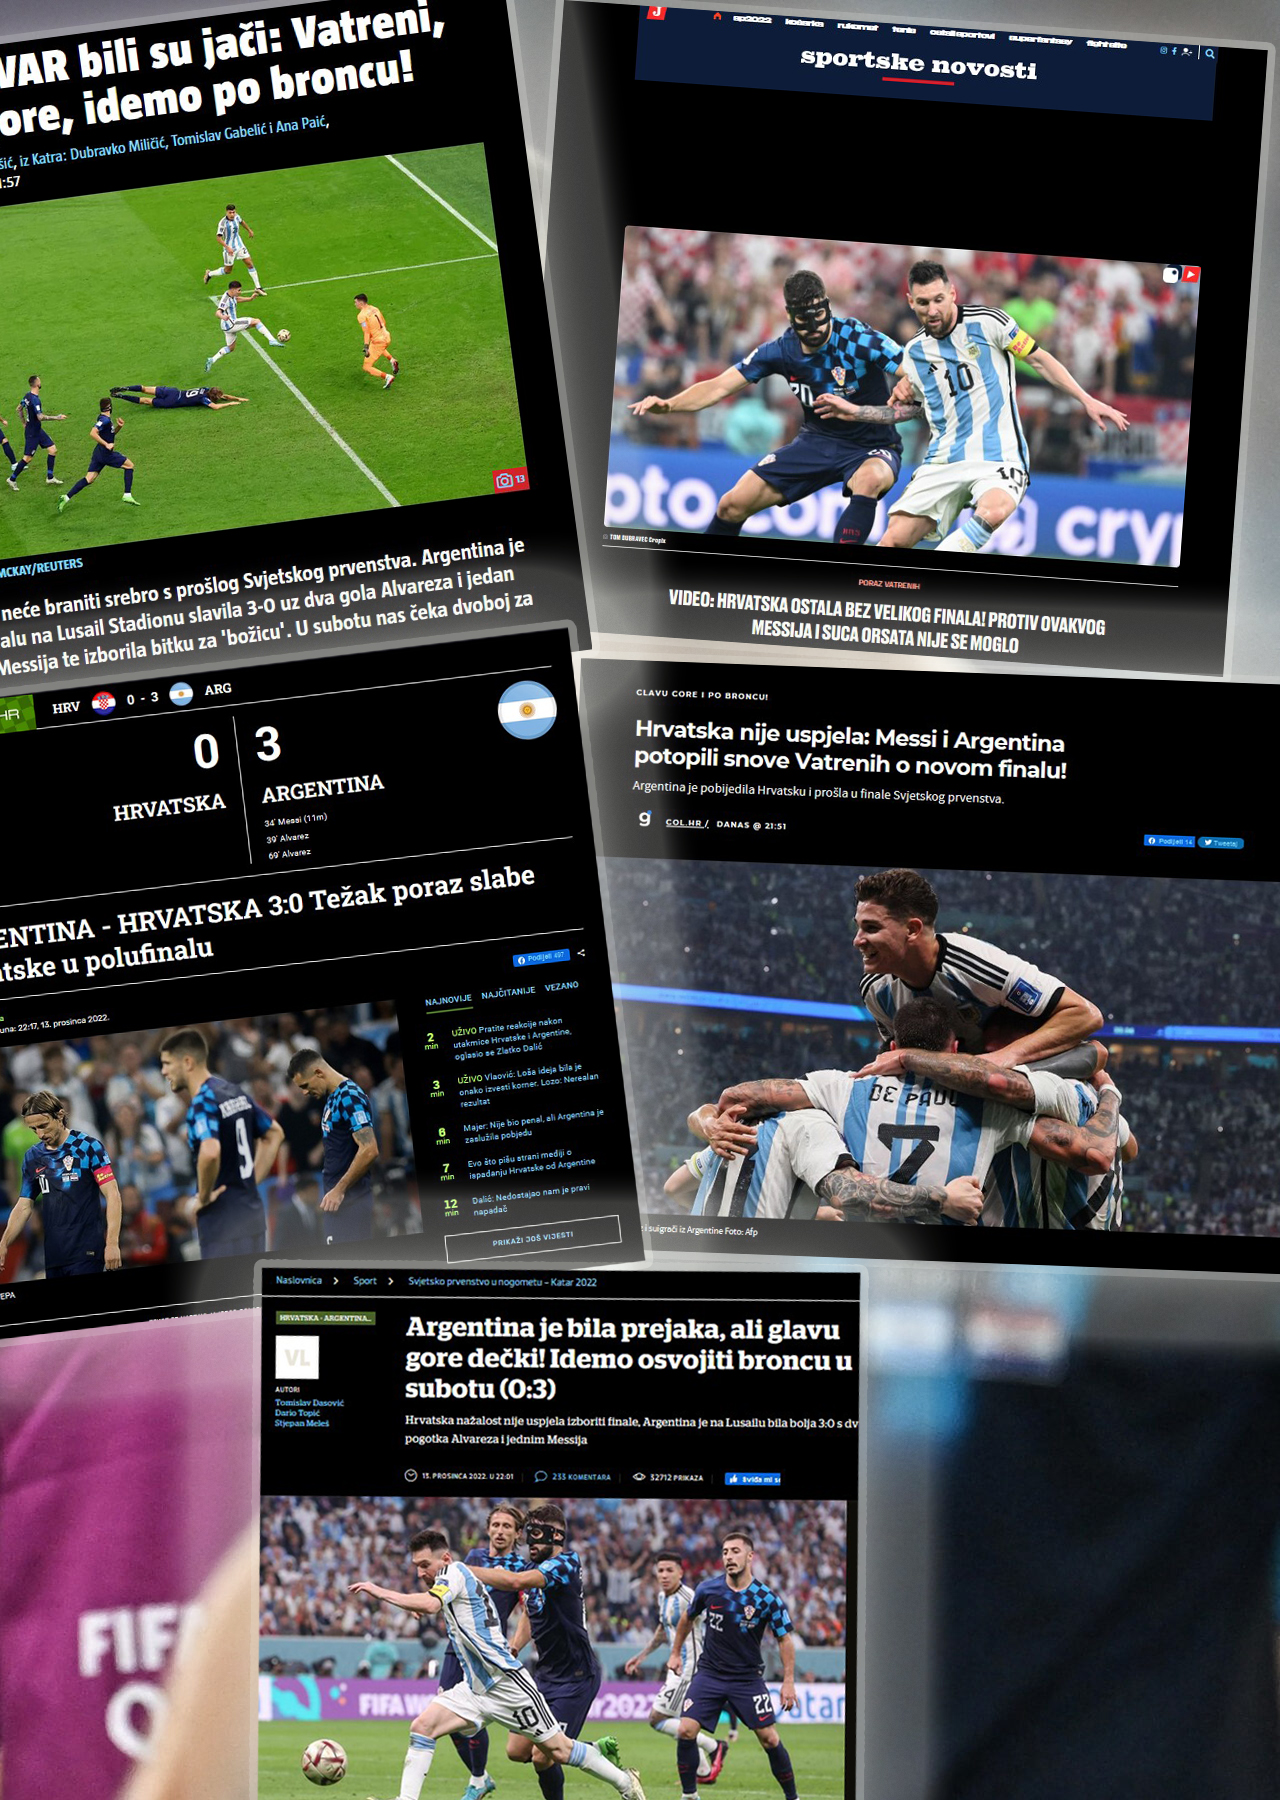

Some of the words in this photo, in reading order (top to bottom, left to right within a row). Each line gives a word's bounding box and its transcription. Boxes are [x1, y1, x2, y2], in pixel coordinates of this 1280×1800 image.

[943, 362, 975, 398] 10
[869, 1083, 898, 1104] DE
[235, 1117, 255, 1180] 9
[877, 1122, 941, 1185] 7
[708, 1611, 724, 1633] 22
[752, 1693, 773, 1715] 22
[512, 1705, 540, 1731] 10
